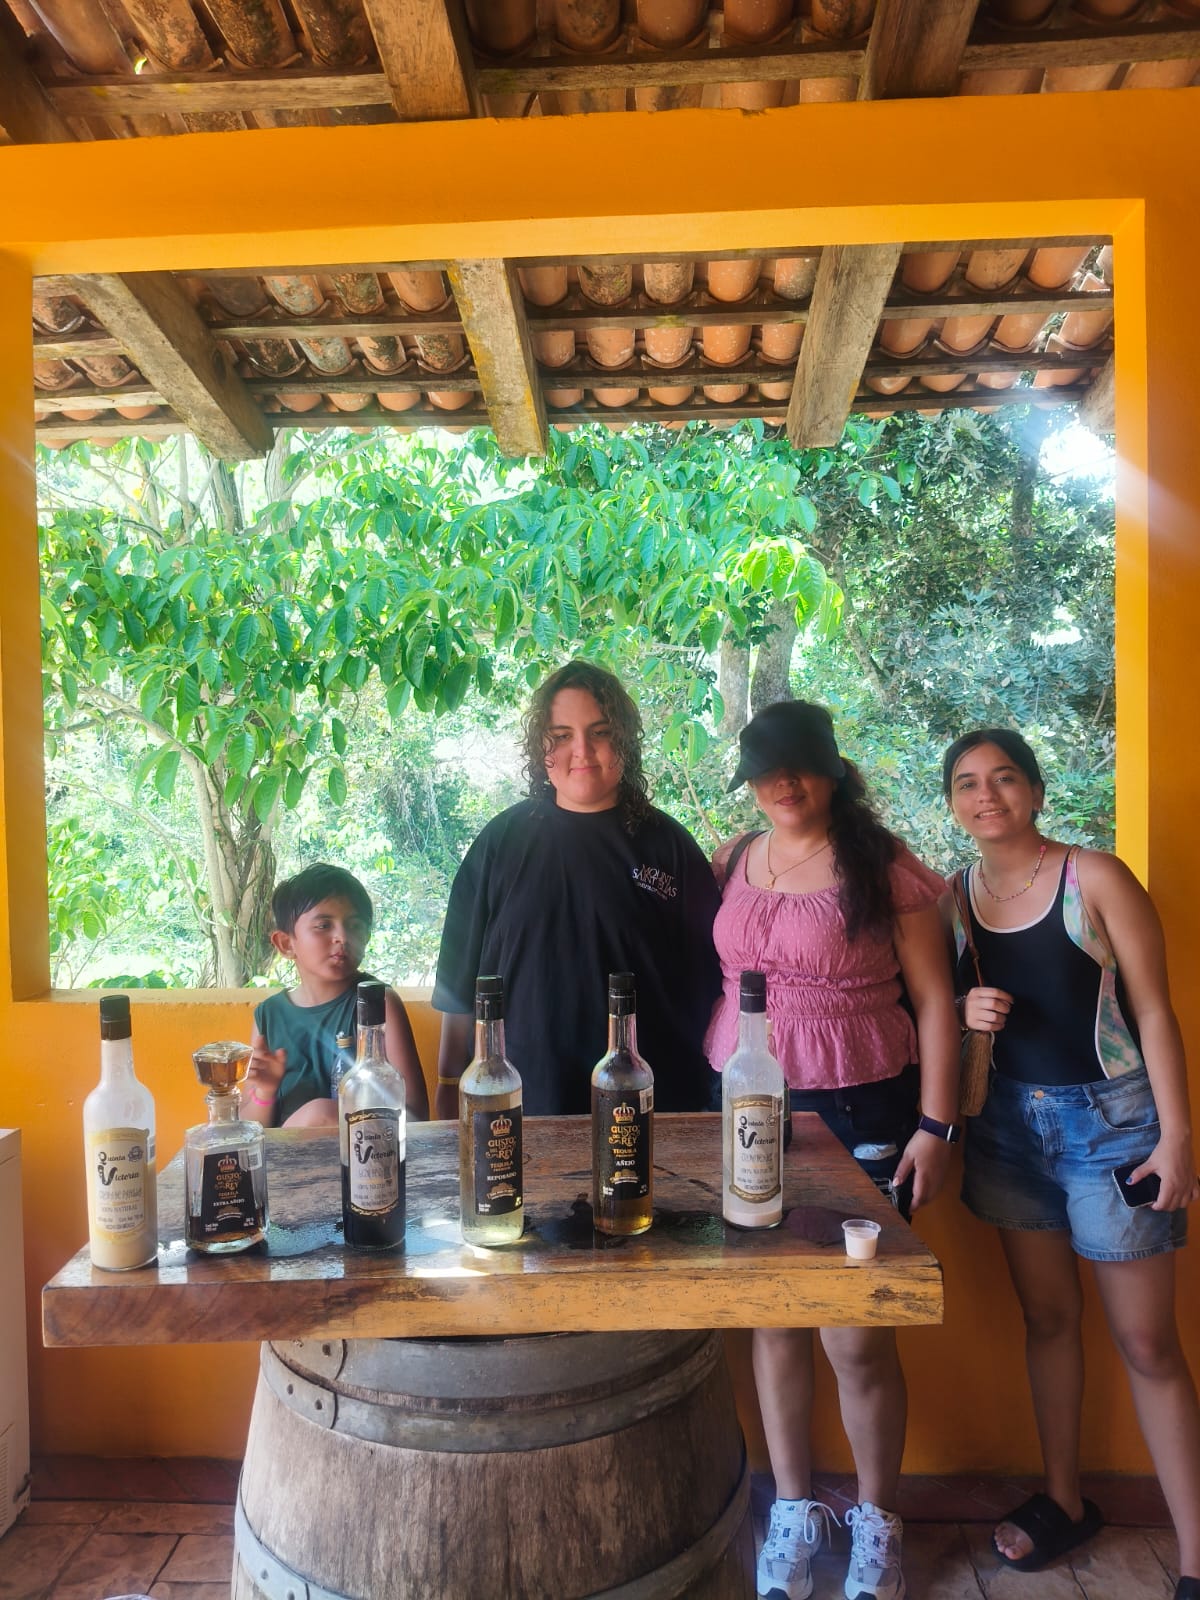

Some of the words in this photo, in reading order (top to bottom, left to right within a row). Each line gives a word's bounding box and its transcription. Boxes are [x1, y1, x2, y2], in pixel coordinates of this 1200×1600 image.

[739, 1116, 764, 1129] Quinta
[611, 1126, 638, 1134] GUSTO
[355, 1130, 381, 1144] Quinta
[488, 1136, 515, 1147] GUSTO
[621, 1136, 638, 1146] REY
[98, 1152, 126, 1165] Quinta
[498, 1149, 514, 1159] REY
[98, 1165, 140, 1186] Victoria
[487, 1172, 517, 1181] REPOSADO
